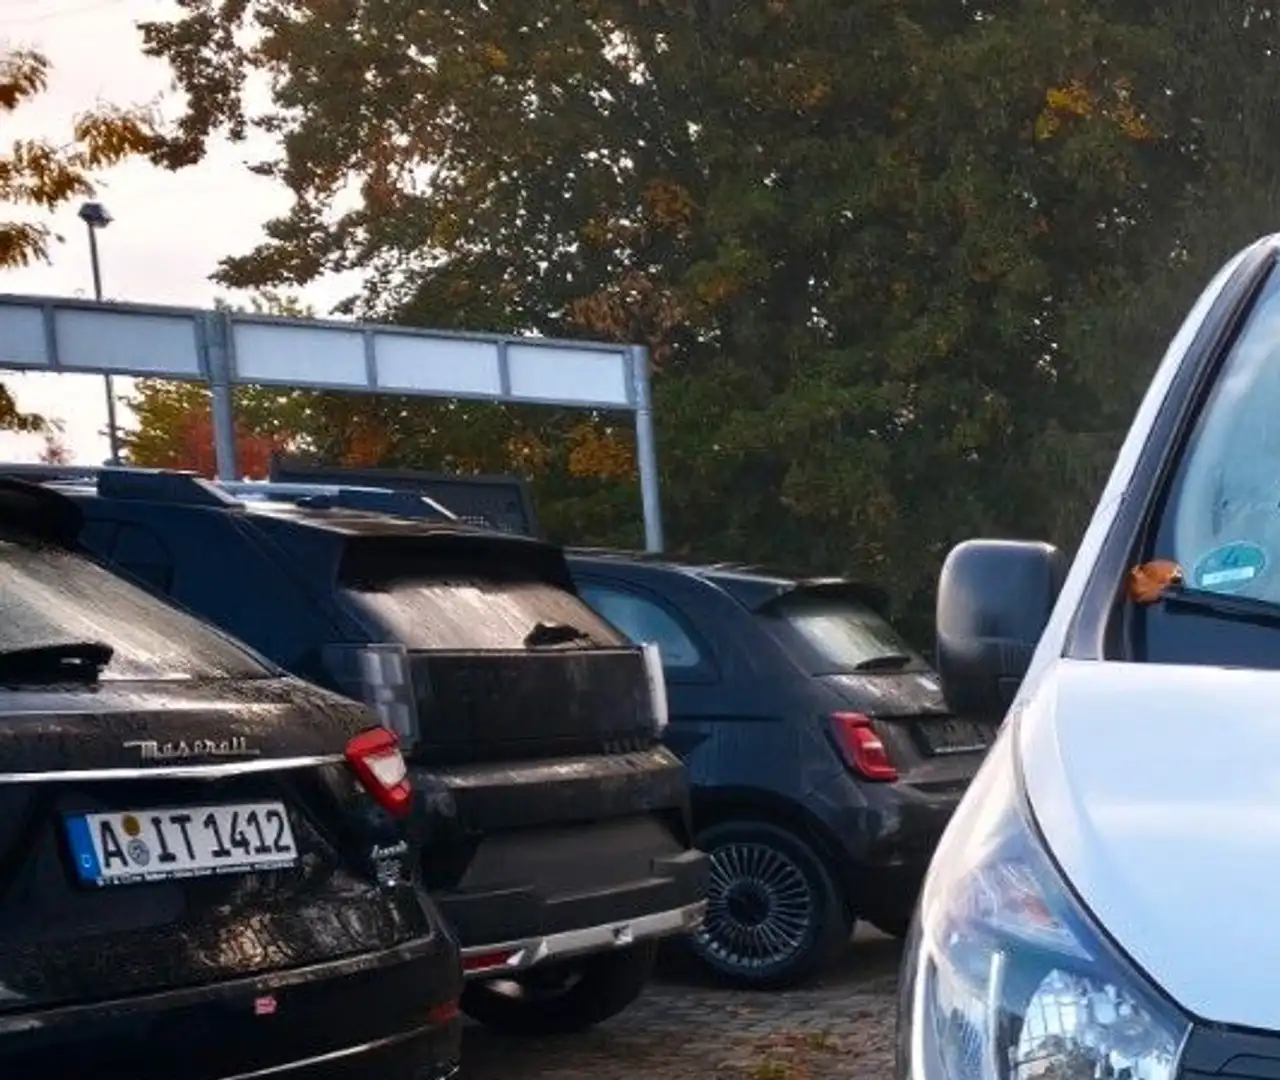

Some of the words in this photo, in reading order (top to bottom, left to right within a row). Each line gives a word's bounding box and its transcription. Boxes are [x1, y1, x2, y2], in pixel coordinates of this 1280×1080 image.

[101, 820, 129, 868] A
[151, 814, 196, 862] IT
[204, 809, 291, 858] 1412
